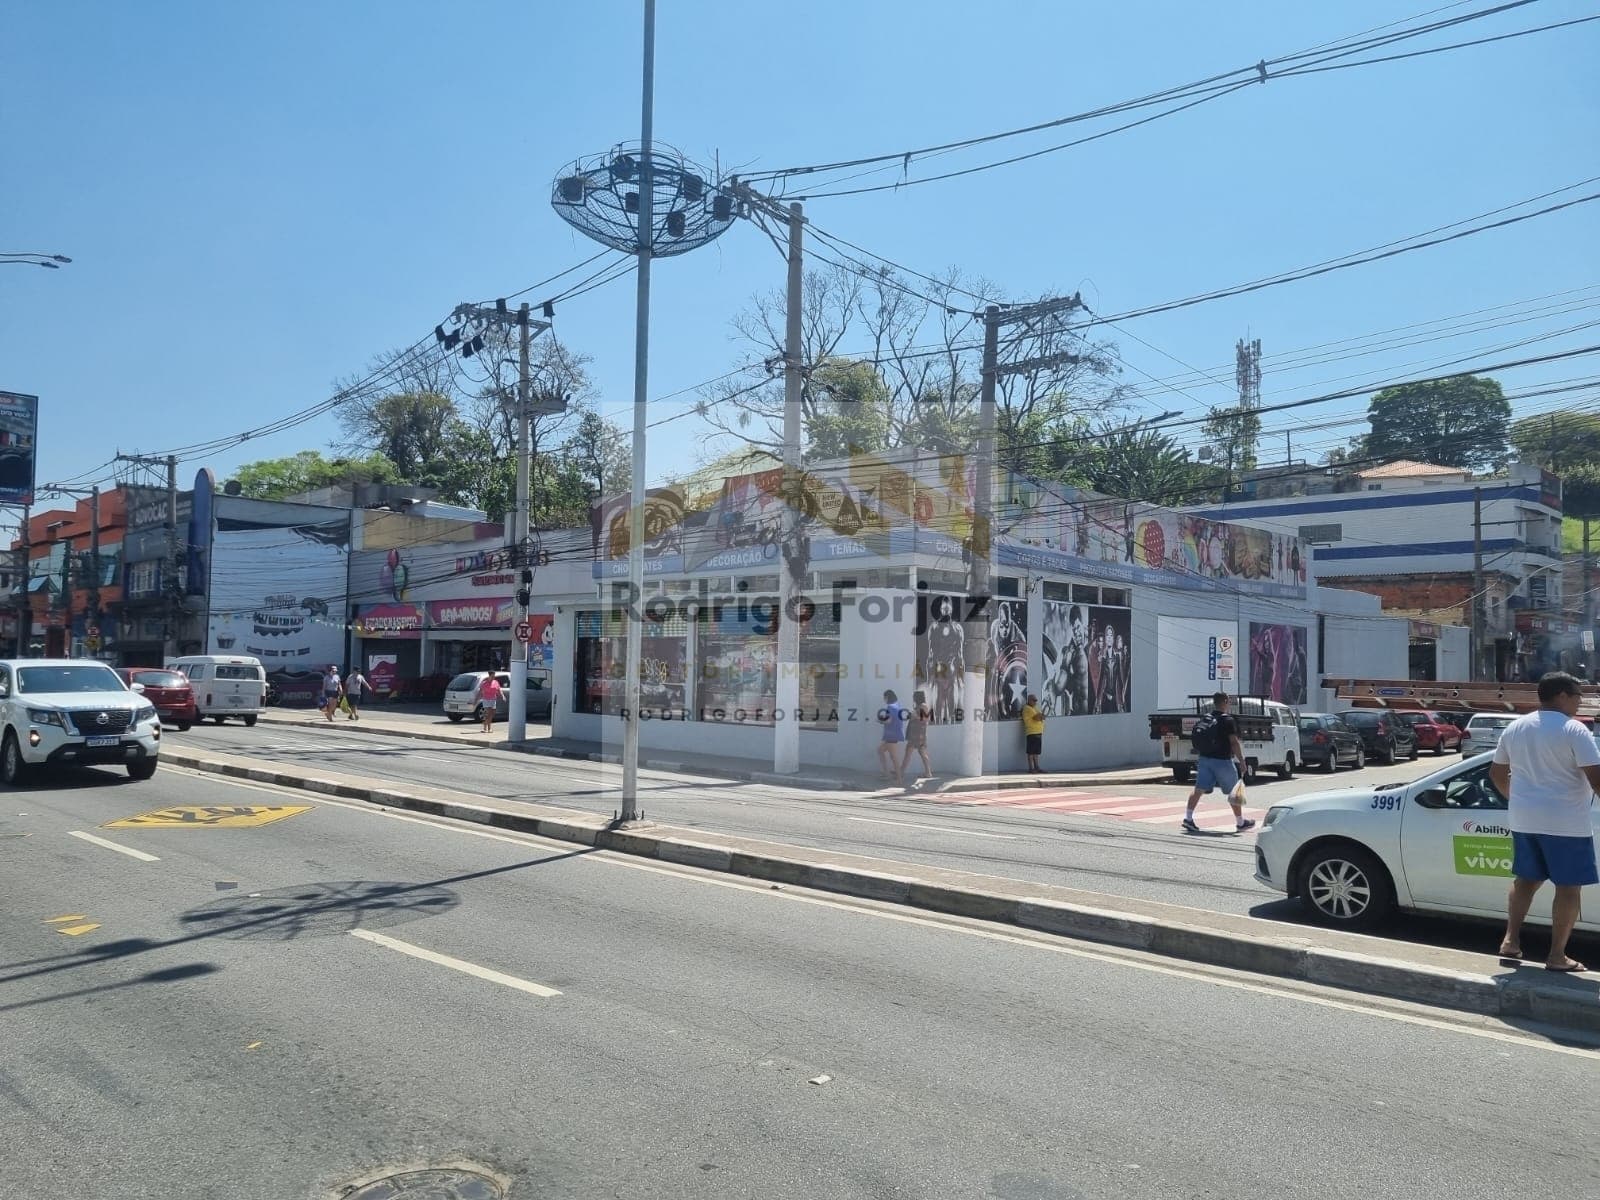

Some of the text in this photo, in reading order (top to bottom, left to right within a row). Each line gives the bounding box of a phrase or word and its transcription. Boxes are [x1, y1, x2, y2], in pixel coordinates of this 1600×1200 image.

[135, 502, 168, 524] ADVOCAC
[829, 542, 866, 556] TEMAS
[707, 550, 762, 568] DECORAÇÃO
[612, 561, 663, 574] CHOATES
[1371, 795, 1402, 811] 3991
[1474, 824, 1511, 837] Ability
[1463, 851, 1513, 870] vivo
